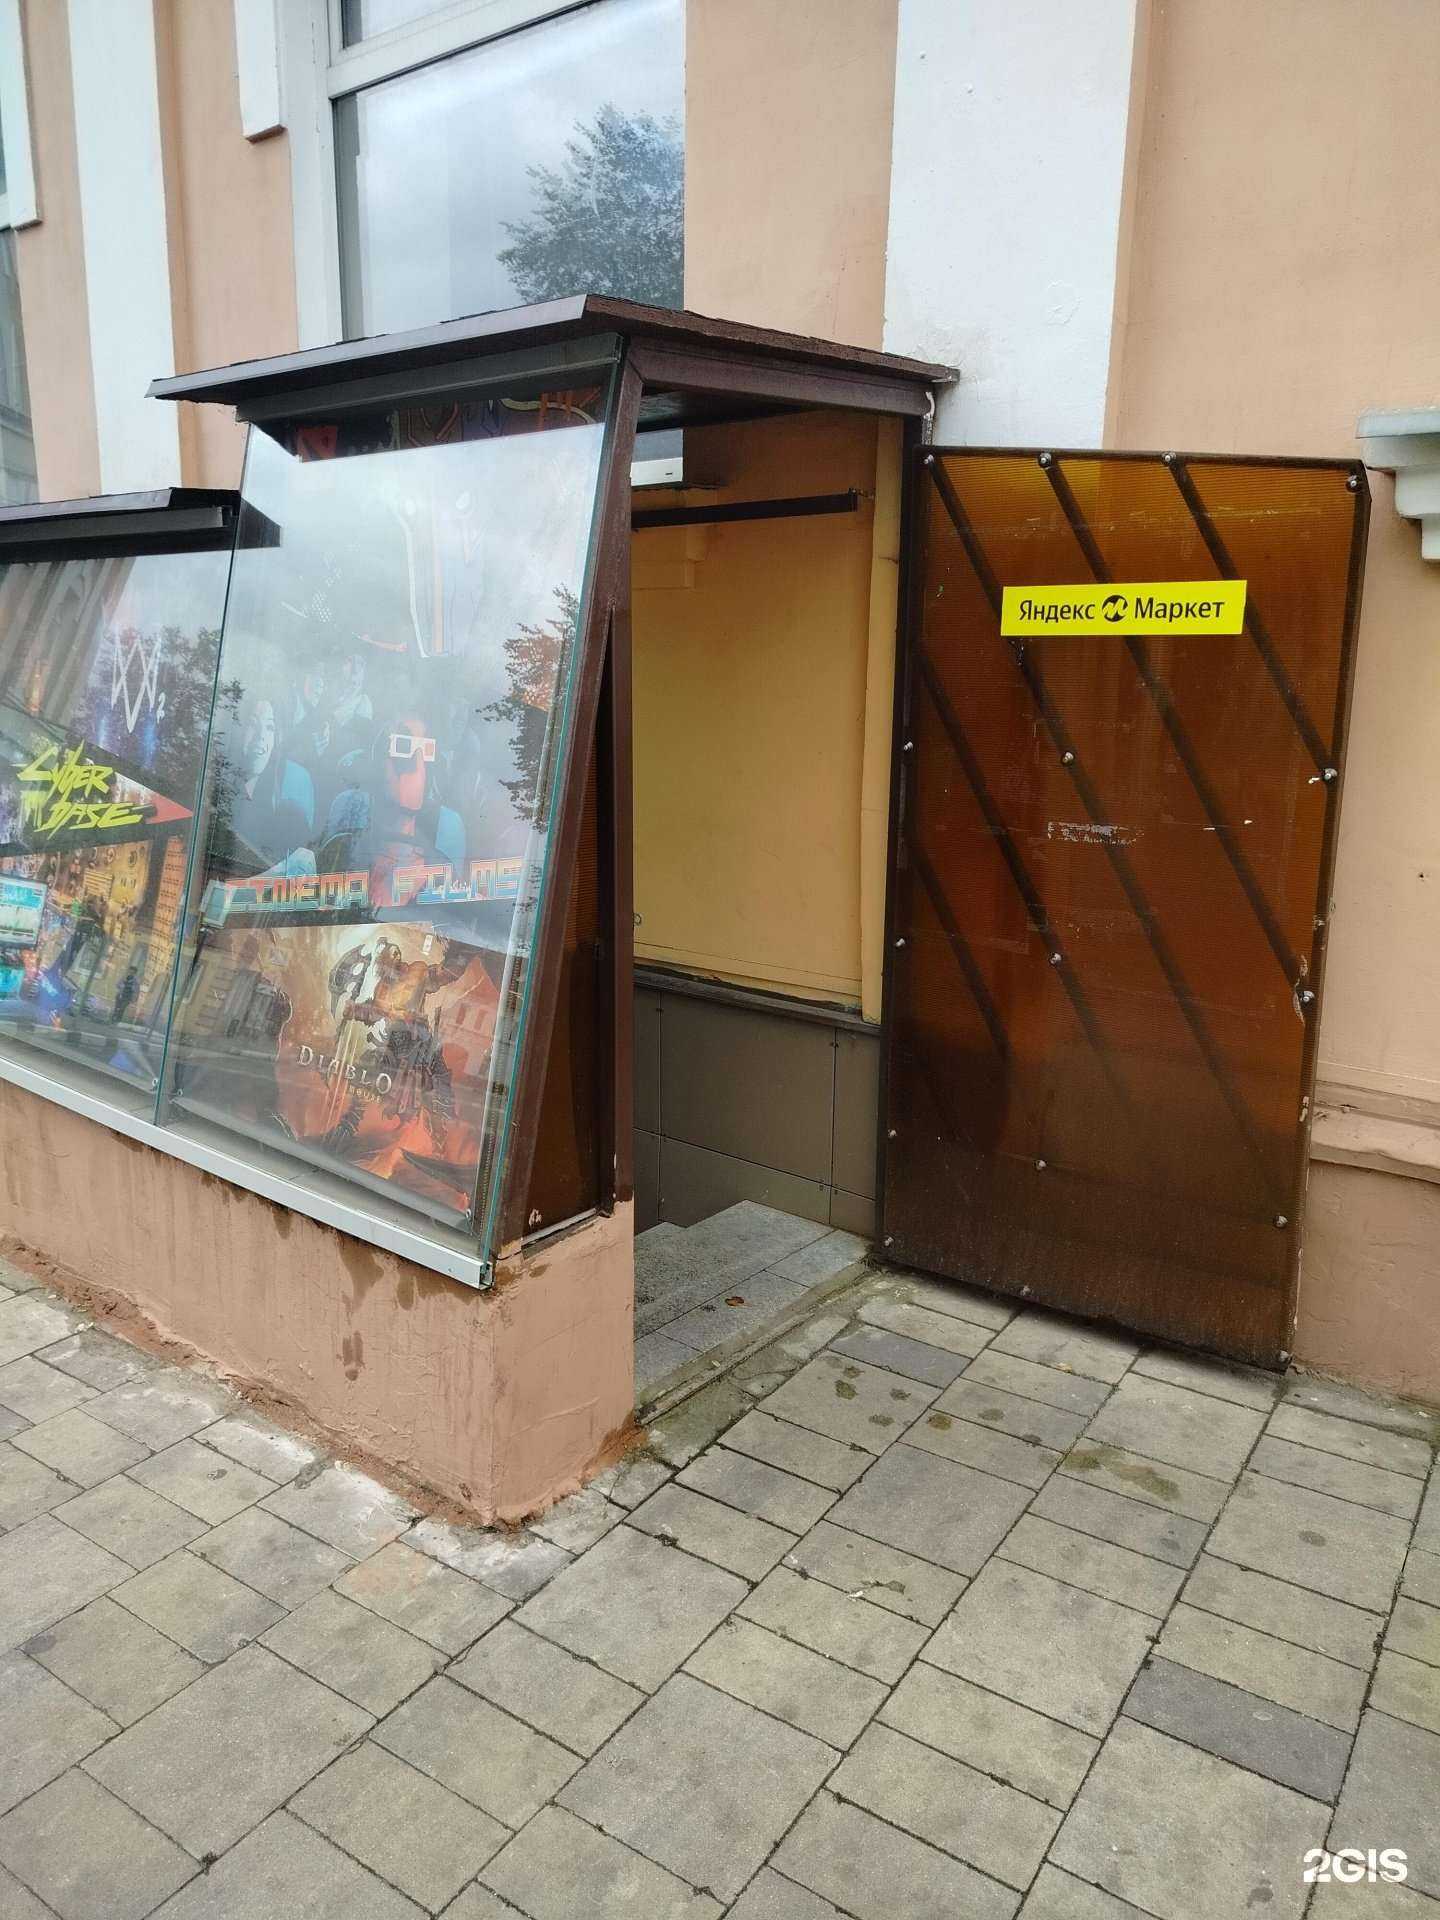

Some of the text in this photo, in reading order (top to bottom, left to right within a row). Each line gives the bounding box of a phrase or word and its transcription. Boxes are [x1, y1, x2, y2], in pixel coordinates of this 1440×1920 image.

[1018, 597, 1226, 623] Яндекс Маркет
[224, 869, 370, 914] CINEMA
